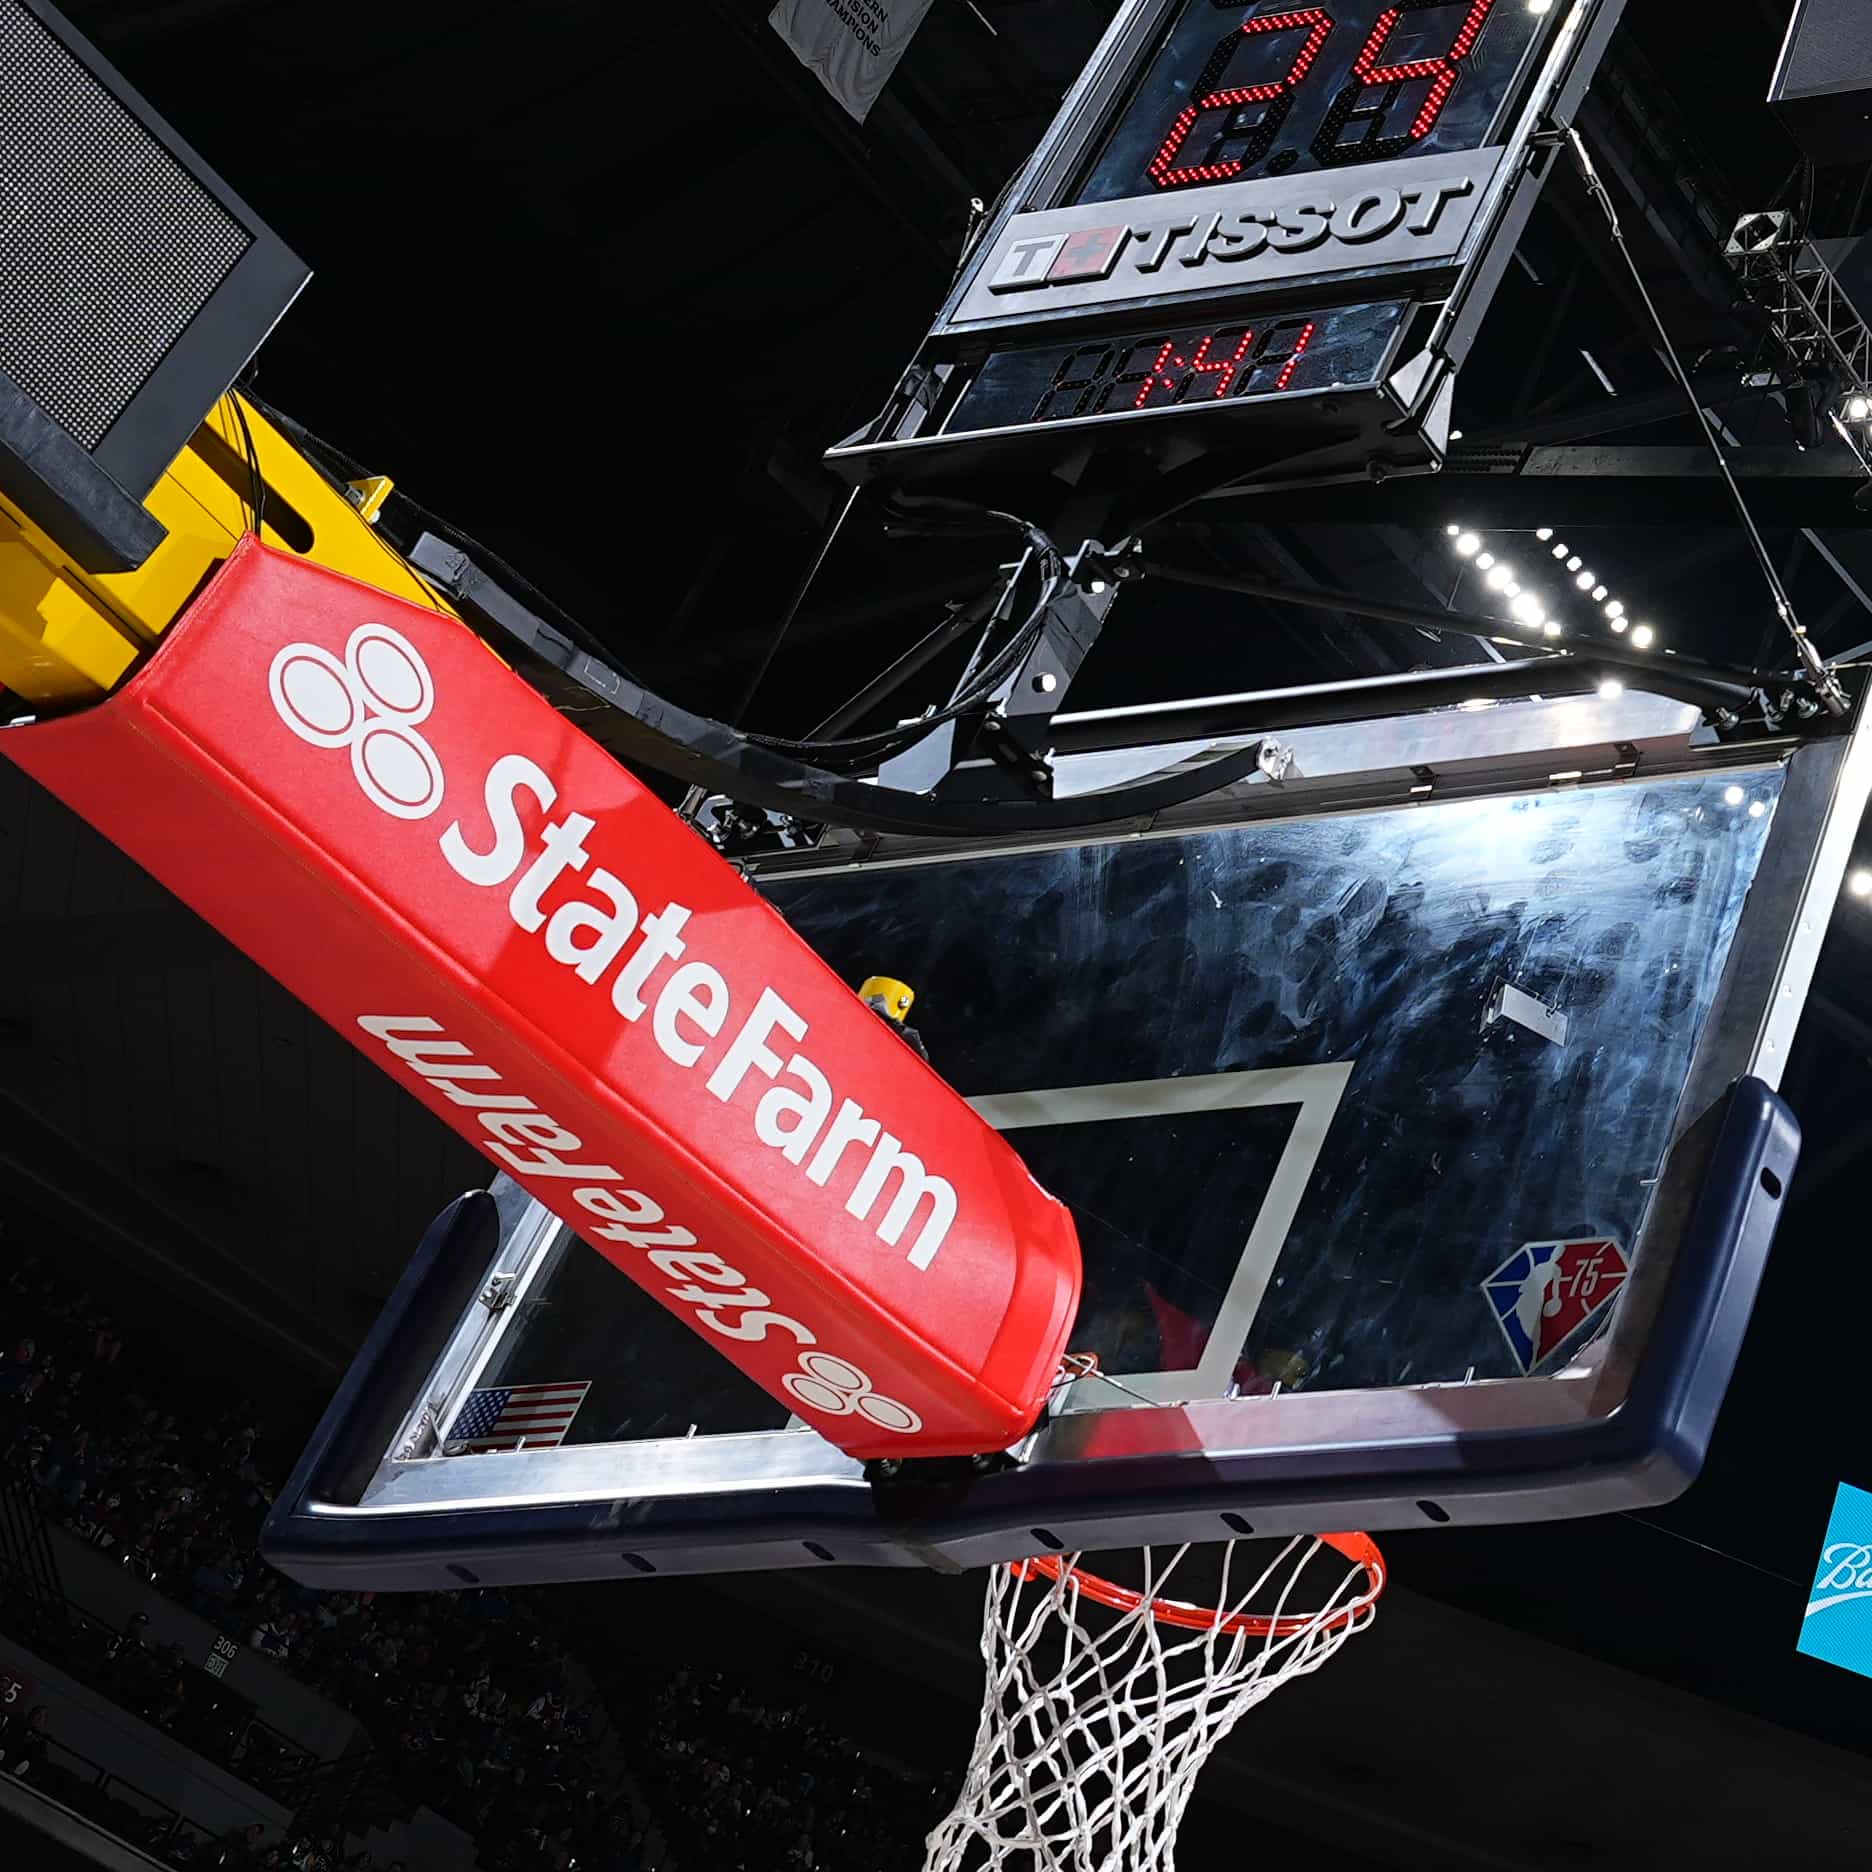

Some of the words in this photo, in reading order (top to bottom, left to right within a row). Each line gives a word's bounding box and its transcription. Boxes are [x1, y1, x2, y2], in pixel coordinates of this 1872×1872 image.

[1130, 176, 1473, 272] TISSOT
[1134, 320, 1315, 412] 1:41
[1568, 1257, 1605, 1298] 75
[212, 1633, 241, 1660] 306
